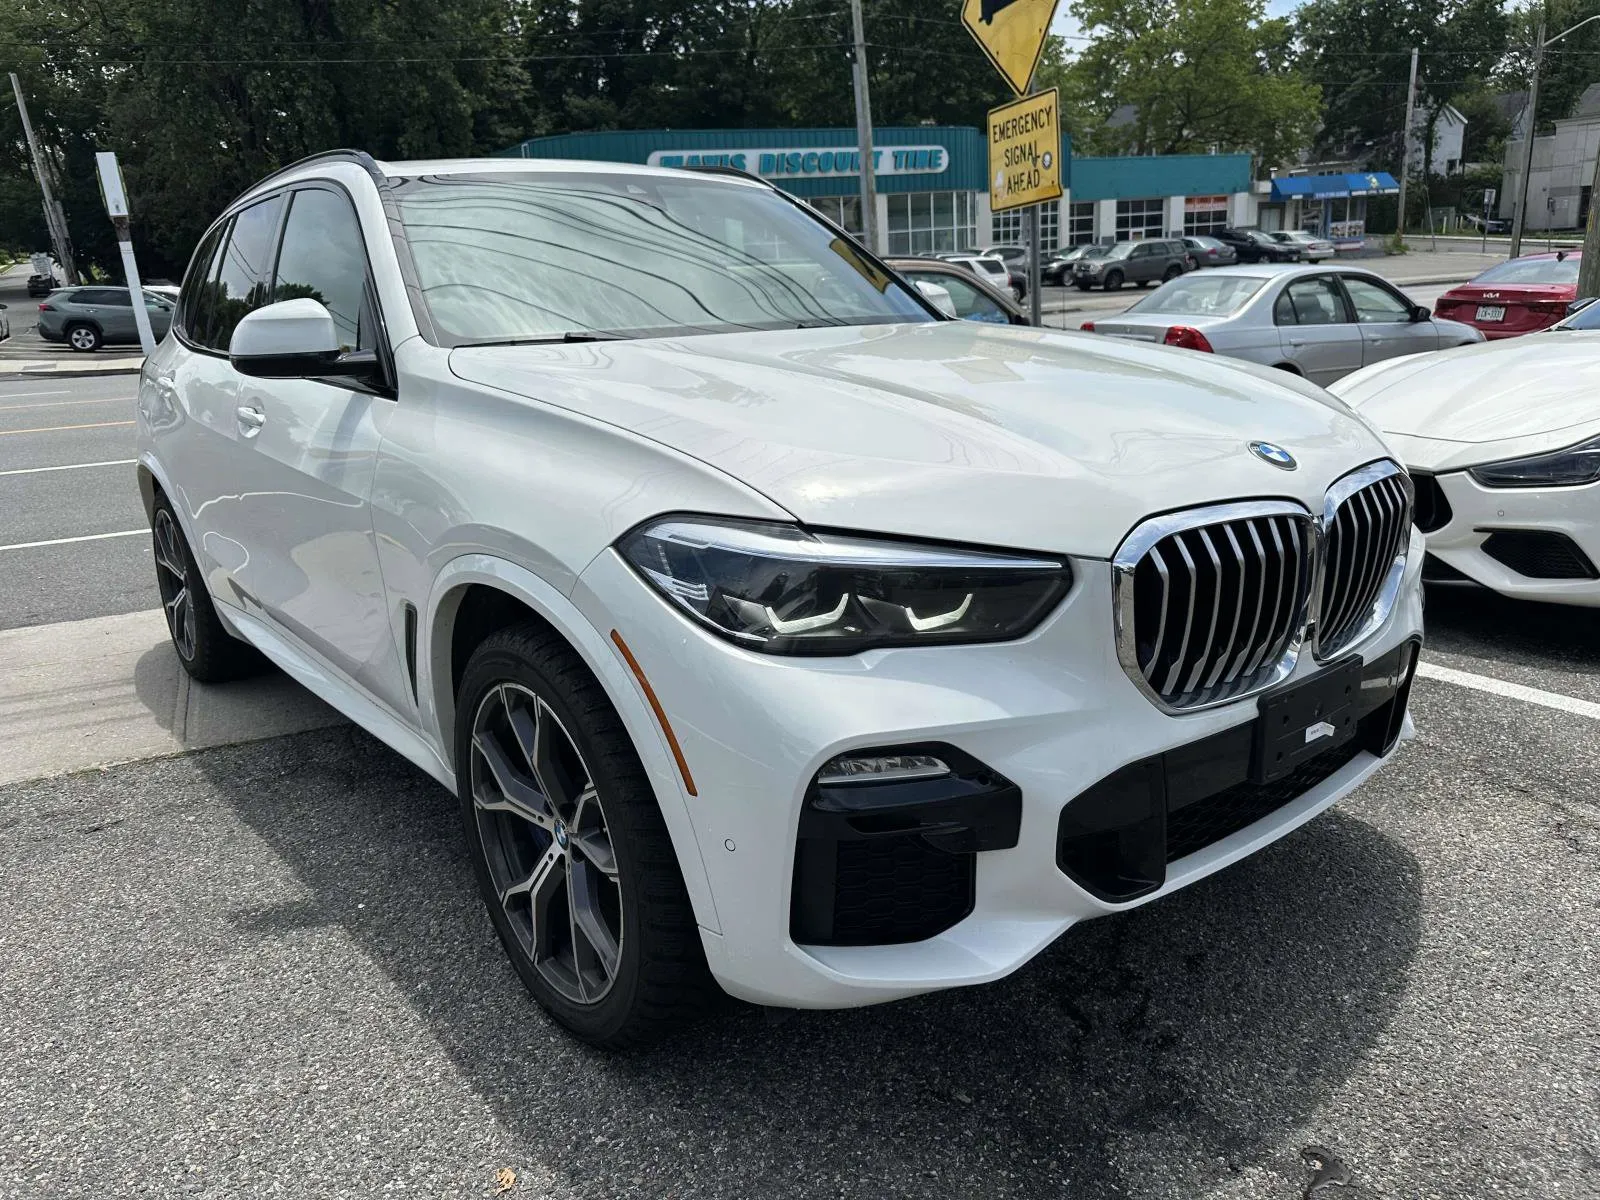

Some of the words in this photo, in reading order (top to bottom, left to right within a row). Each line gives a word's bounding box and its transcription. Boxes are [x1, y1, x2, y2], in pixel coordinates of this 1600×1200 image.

[992, 105, 1052, 144] EMERGENCY
[1004, 140, 1040, 168] SIGNAL
[1006, 168, 1040, 196] AHEAD
